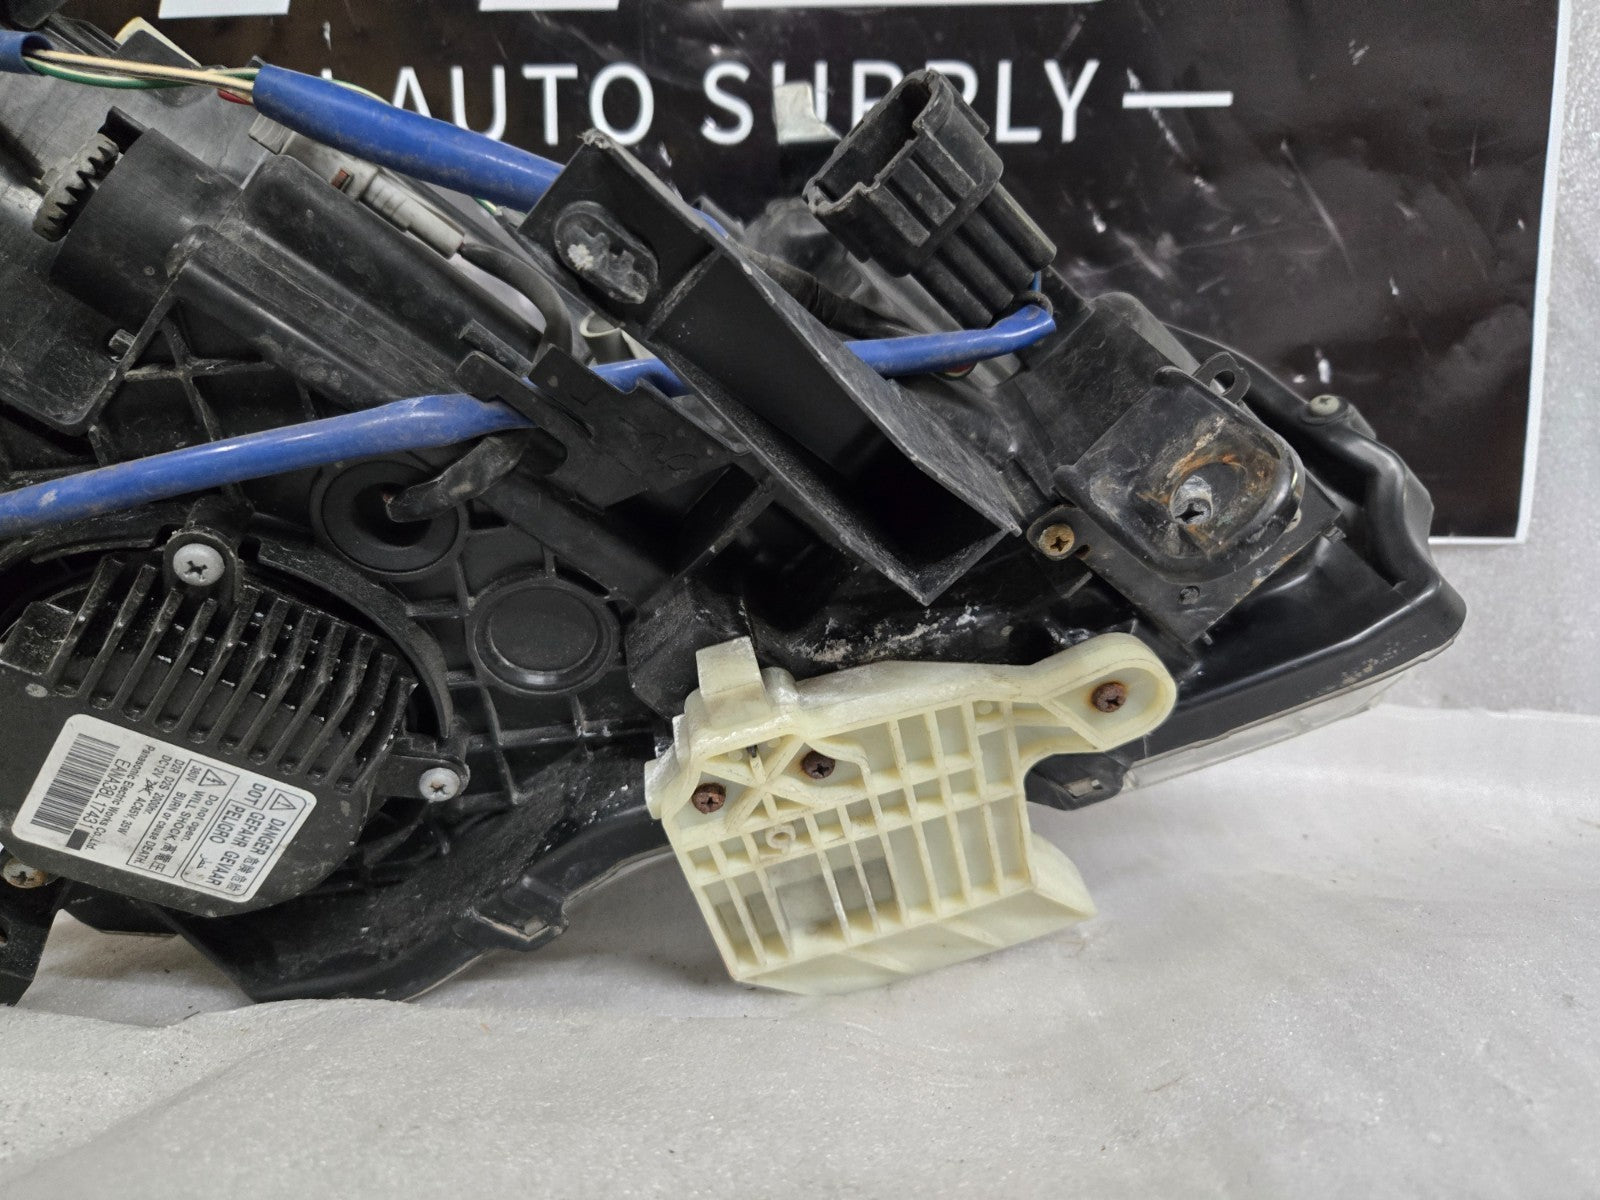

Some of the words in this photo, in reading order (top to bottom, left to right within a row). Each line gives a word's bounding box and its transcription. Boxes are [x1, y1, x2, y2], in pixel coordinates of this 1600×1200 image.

[392, 62, 654, 145] AUTO
[125, 744, 155, 781] Panasonic
[150, 753, 172, 778] DC12V
[167, 758, 185, 774] D2R
[183, 764, 202, 783] 380V
[110, 779, 134, 806] Electric
[157, 775, 175, 791] D2S
[241, 782, 267, 805] DOT
[165, 790, 187, 812] BURN
[184, 789, 205, 810] WILL
[203, 793, 219, 807] Do
[98, 805, 119, 827] Works
[160, 811, 172, 821] or
[193, 805, 211, 821] not
[207, 803, 246, 845] PELIGRO
[115, 819, 133, 836] 35W
[147, 819, 167, 840] cause
[162, 810, 192, 843] SHOCK,
[178, 820, 199, 843] open.
[229, 810, 266, 848] GEFAHR
[249, 817, 286, 856] DANGER
[132, 839, 156, 866] DEATH.
[204, 849, 241, 886] GEVAAR
